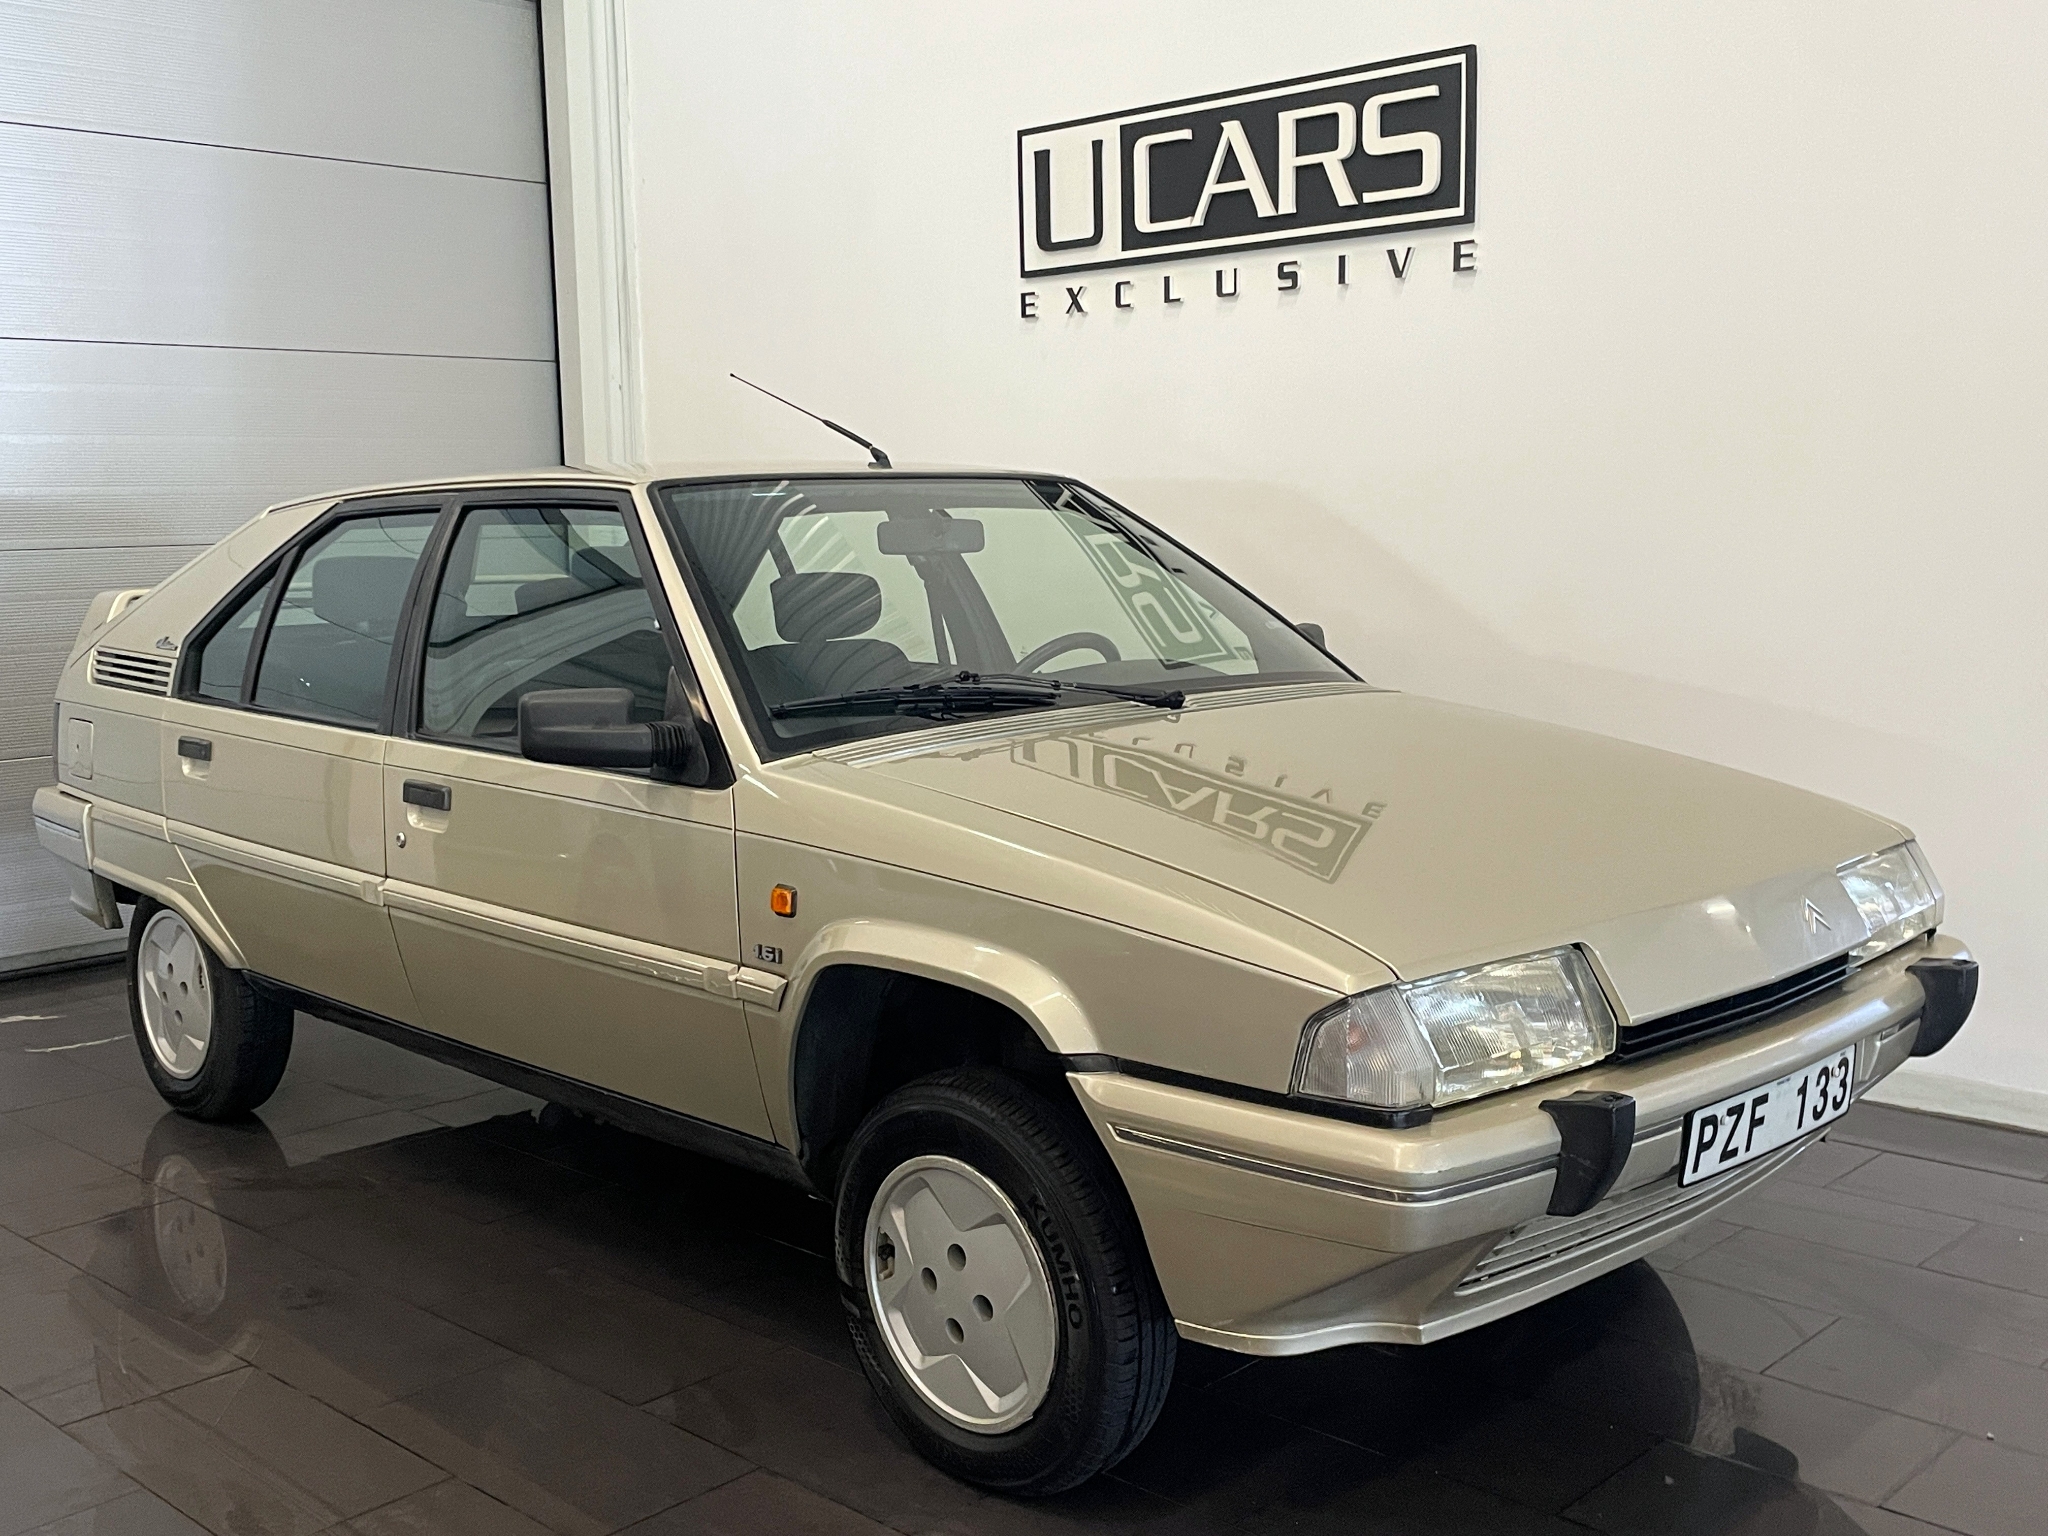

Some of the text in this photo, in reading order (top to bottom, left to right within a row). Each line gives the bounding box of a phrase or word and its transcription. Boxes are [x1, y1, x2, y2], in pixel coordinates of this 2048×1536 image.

[1021, 239, 1478, 319] EXCLUSIVE
[1692, 1057, 1849, 1174] PZF 133
[1027, 1195, 1083, 1330] KUMHO
